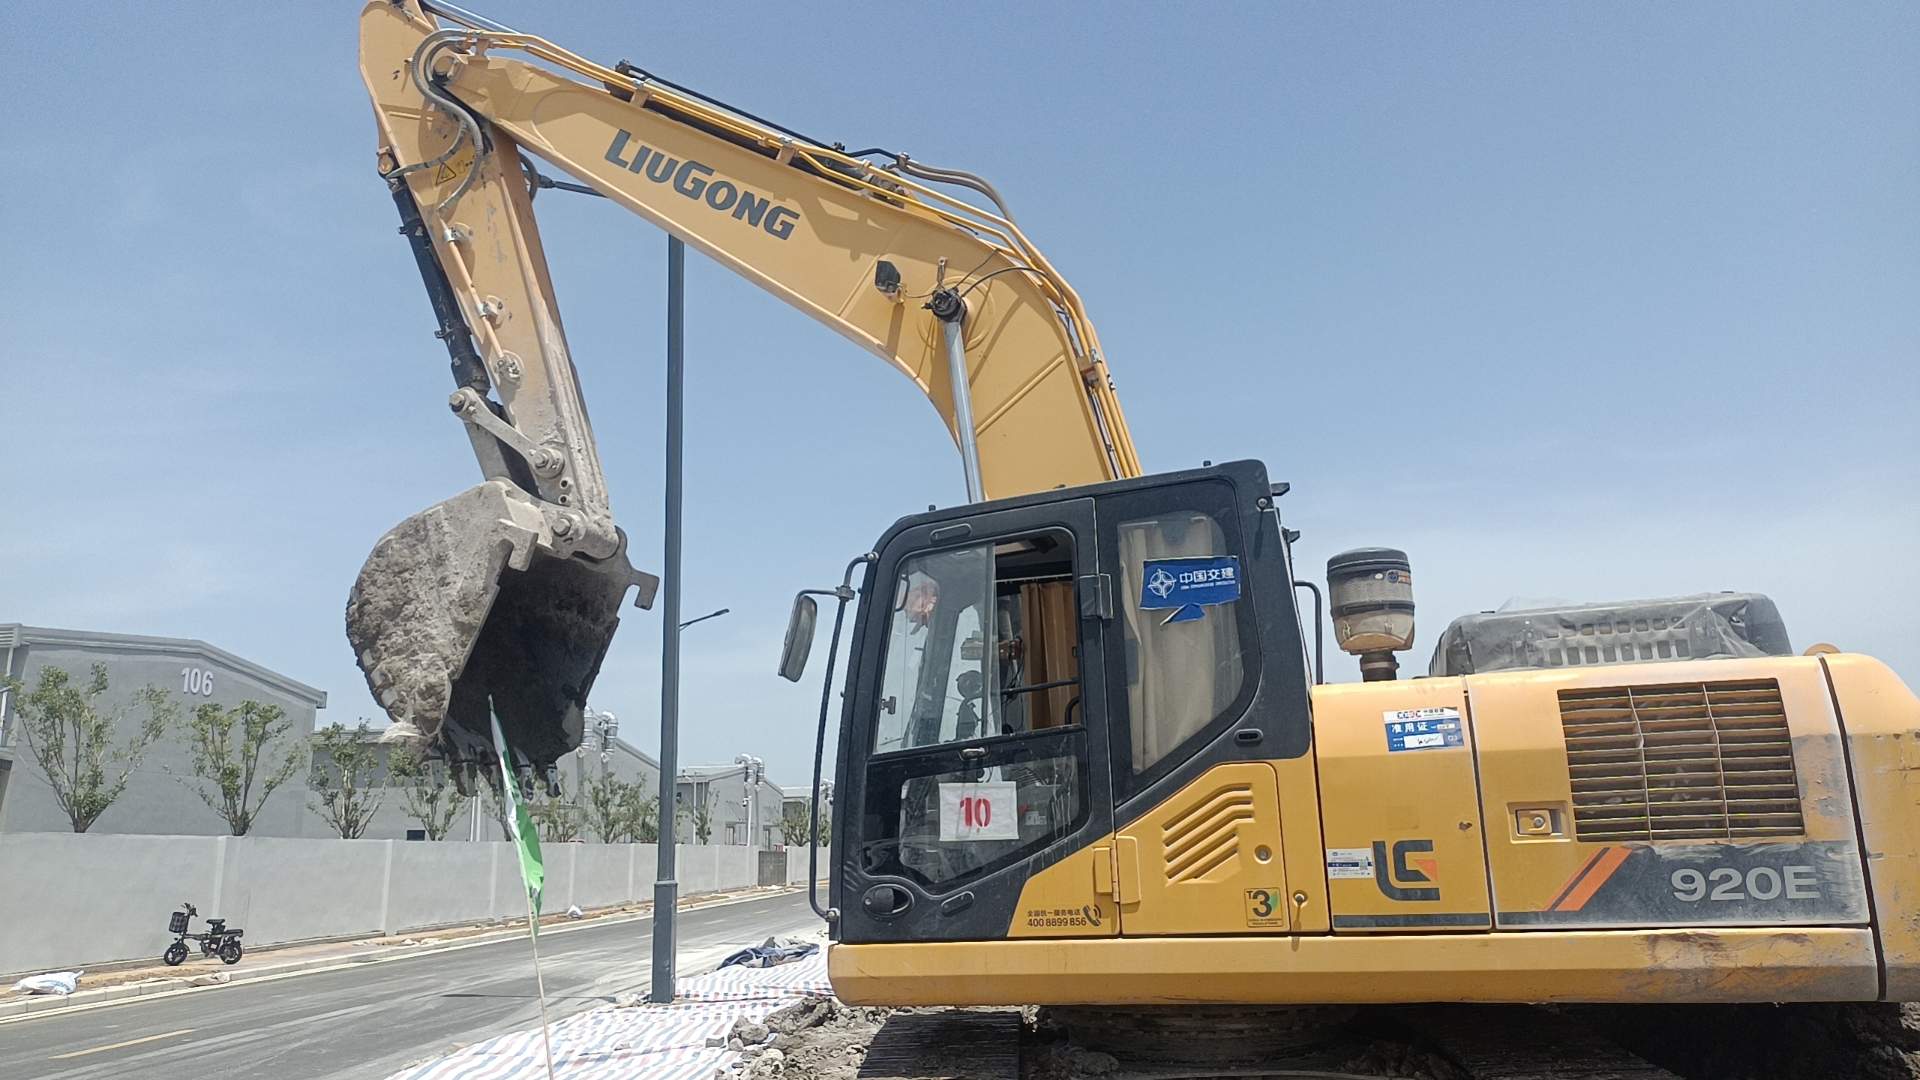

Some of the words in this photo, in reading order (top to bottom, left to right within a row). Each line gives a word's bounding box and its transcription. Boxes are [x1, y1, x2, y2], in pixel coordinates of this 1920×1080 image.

[1179, 567, 1235, 583] 中国交建
[181, 667, 214, 696] 106
[1391, 722, 1429, 733] 准用证
[960, 797, 991, 827] 10
[1671, 866, 1821, 901] 920E
[1027, 909, 1081, 917] 全国统一服务电话
